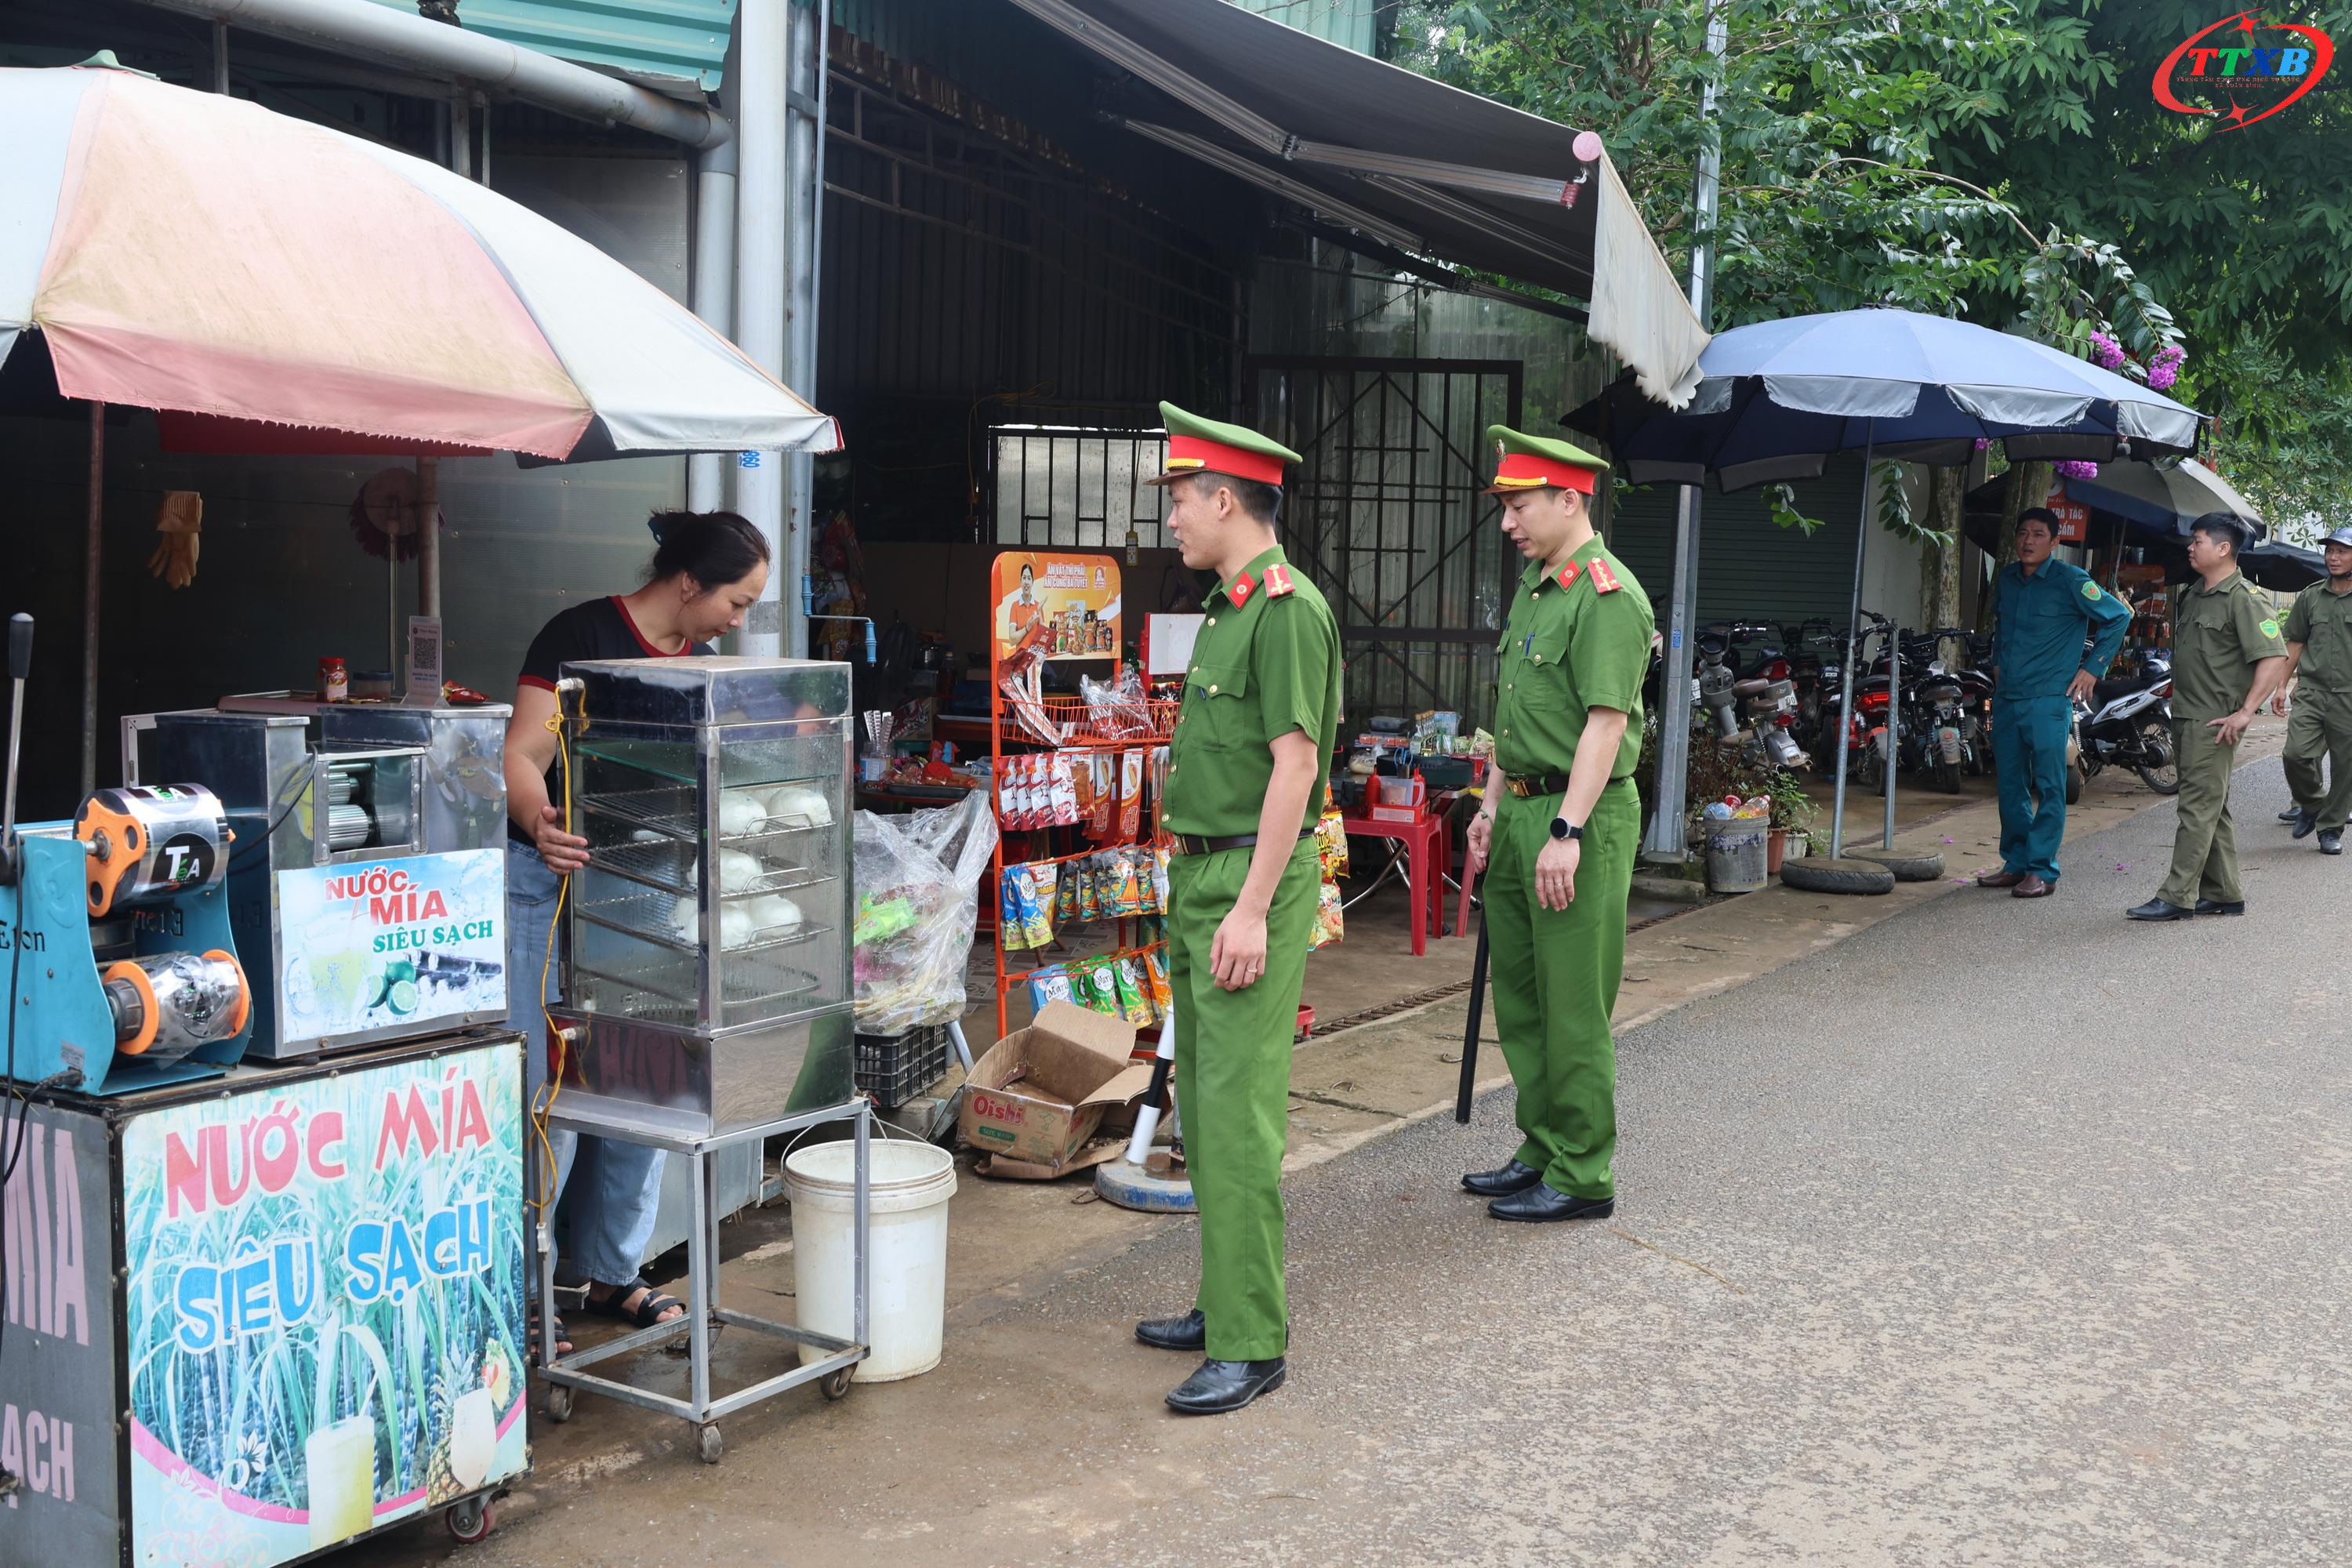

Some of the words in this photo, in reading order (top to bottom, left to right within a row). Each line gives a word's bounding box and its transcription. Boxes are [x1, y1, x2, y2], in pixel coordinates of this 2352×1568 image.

[325, 866, 408, 901] NƯỚC
[369, 884, 448, 926] MÍA
[372, 926, 426, 953] SIÊU
[432, 920, 493, 946] SẠCH
[973, 1094, 1024, 1124] Oishi
[165, 1100, 345, 1218] NƯỚC
[375, 1067, 491, 1171] MÍA
[177, 1237, 315, 1351] SIÊU
[347, 1200, 492, 1305] SẠCH
